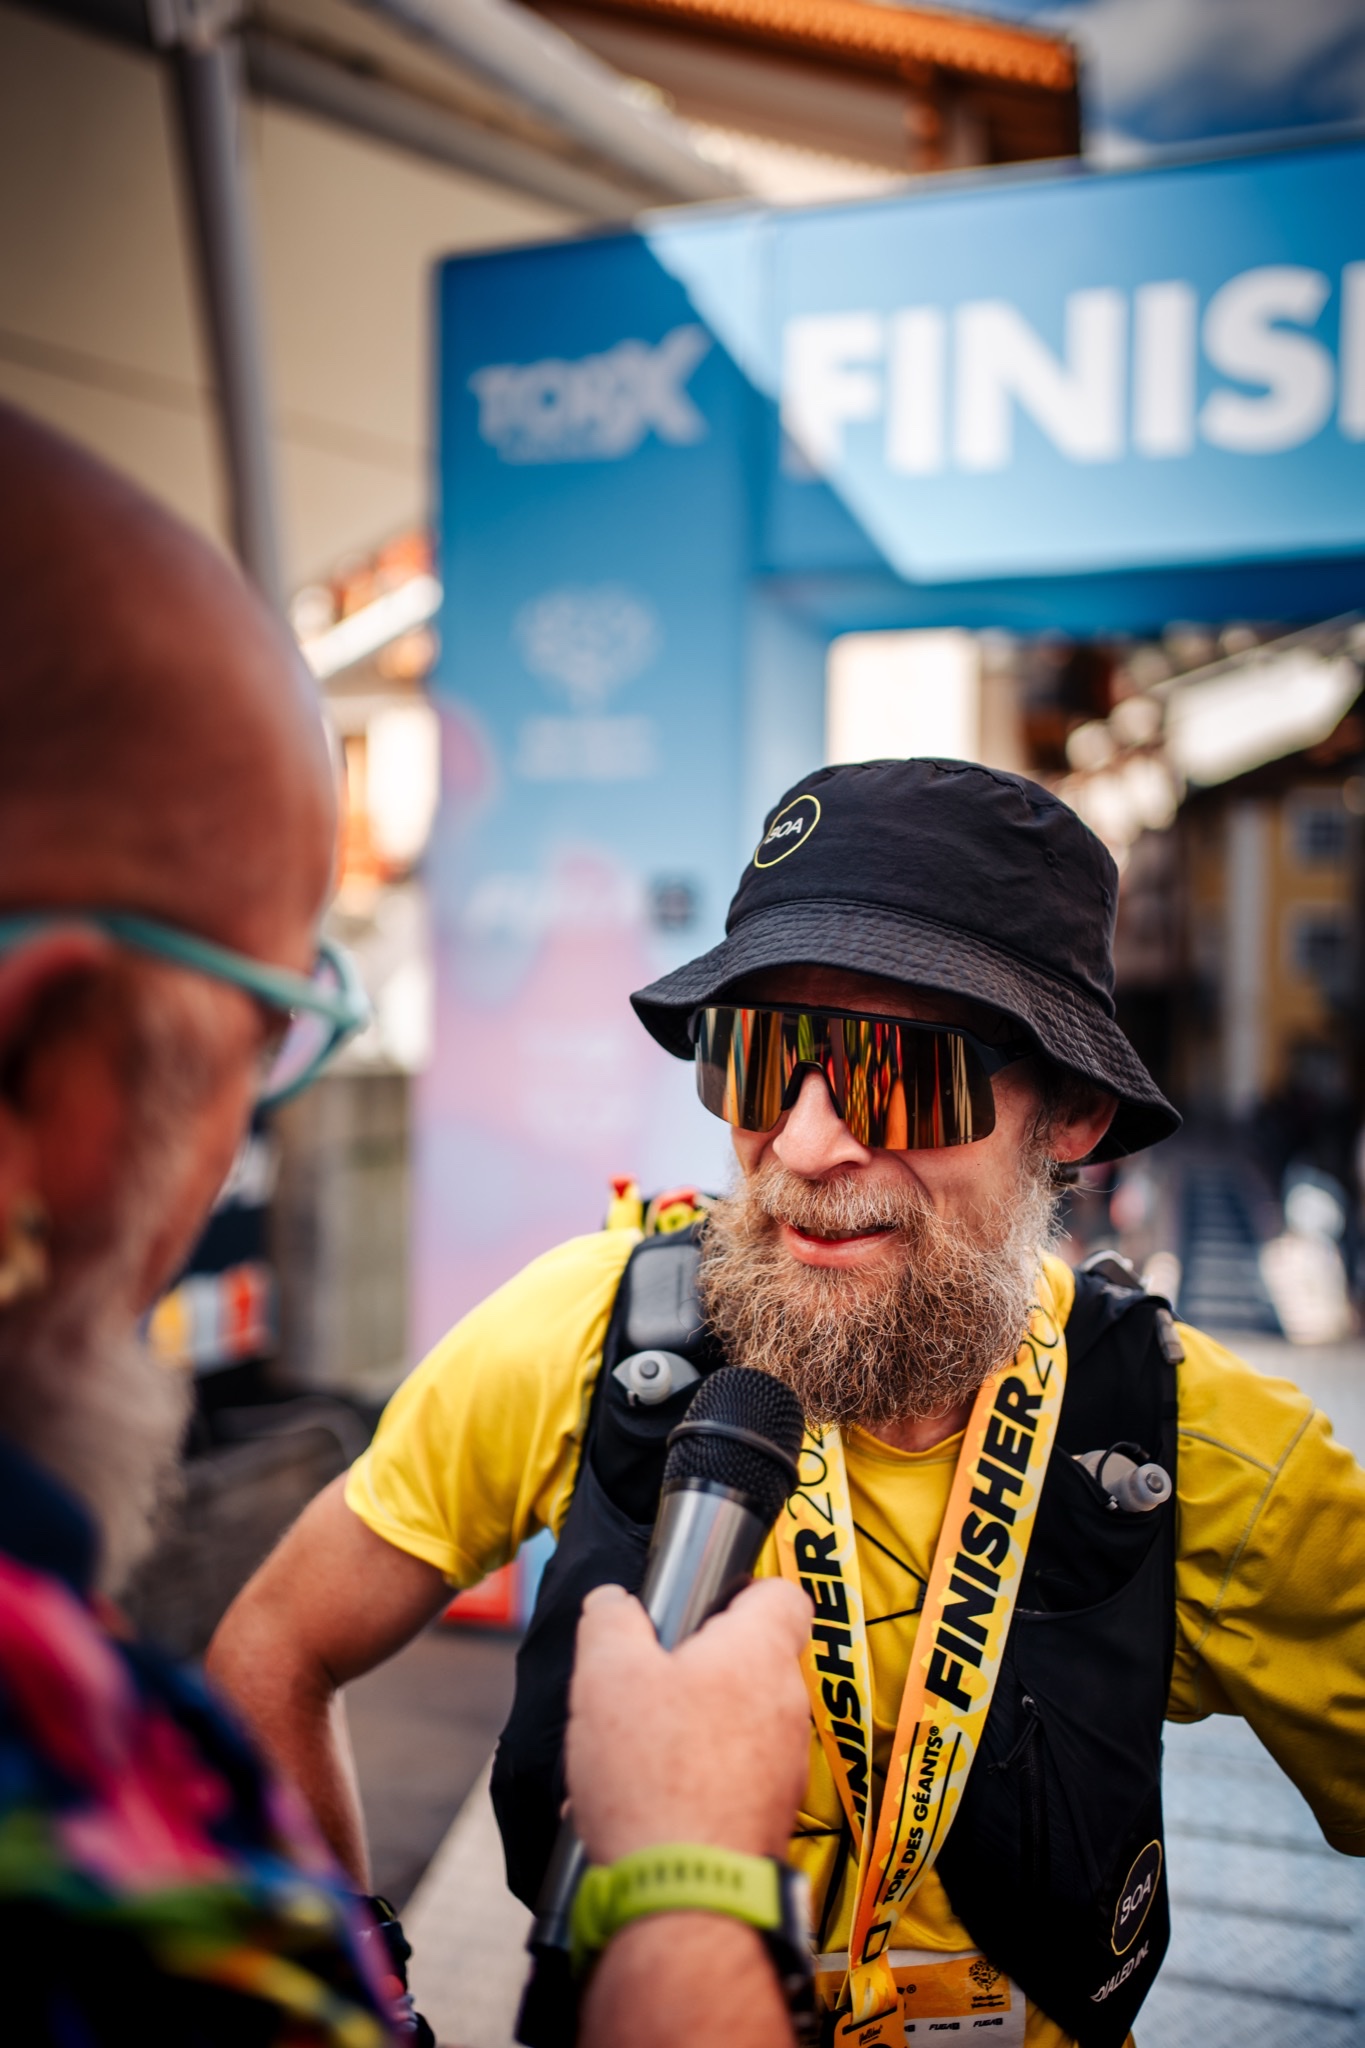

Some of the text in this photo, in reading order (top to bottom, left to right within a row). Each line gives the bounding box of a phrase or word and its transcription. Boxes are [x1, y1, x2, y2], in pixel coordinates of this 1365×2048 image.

[763, 817, 804, 844] BOA
[925, 1376, 1045, 1712] FINISHER
[794, 1529, 868, 1832] INISHER
[882, 1868, 910, 1906] TOR
[902, 1827, 924, 1865] DES
[1120, 1873, 1152, 1925] BOA
[1090, 1957, 1135, 2002] DIALED
